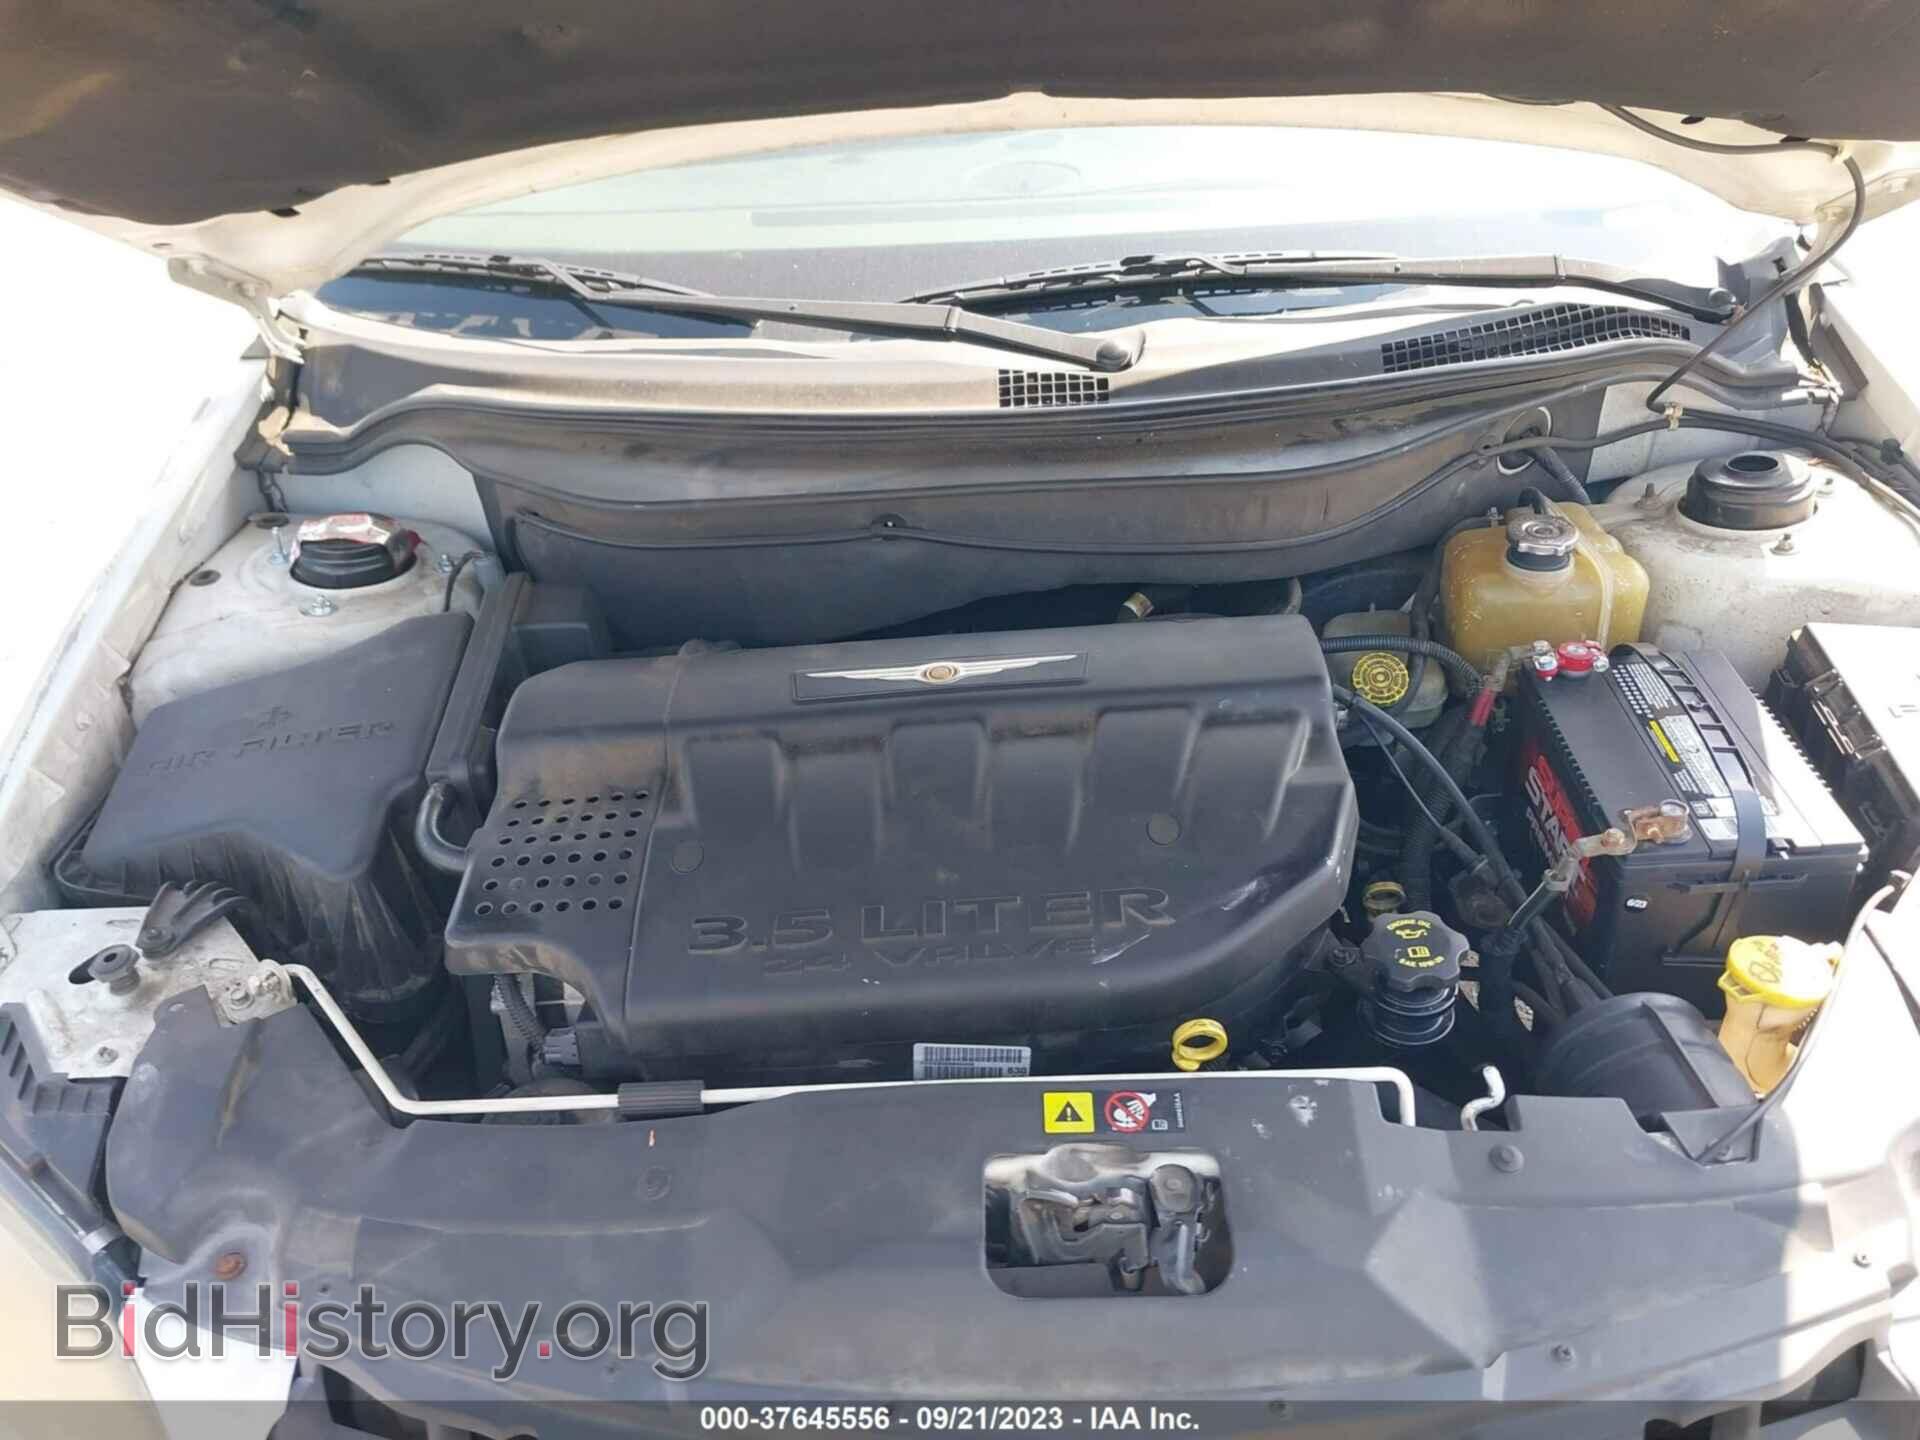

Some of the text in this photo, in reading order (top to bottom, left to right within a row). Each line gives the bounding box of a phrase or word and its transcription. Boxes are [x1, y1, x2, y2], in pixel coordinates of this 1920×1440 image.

[145, 720, 396, 774] AIR FILTER
[687, 886, 1177, 955] 3.5 LITER
[763, 935, 1098, 977] 24 VALVE
